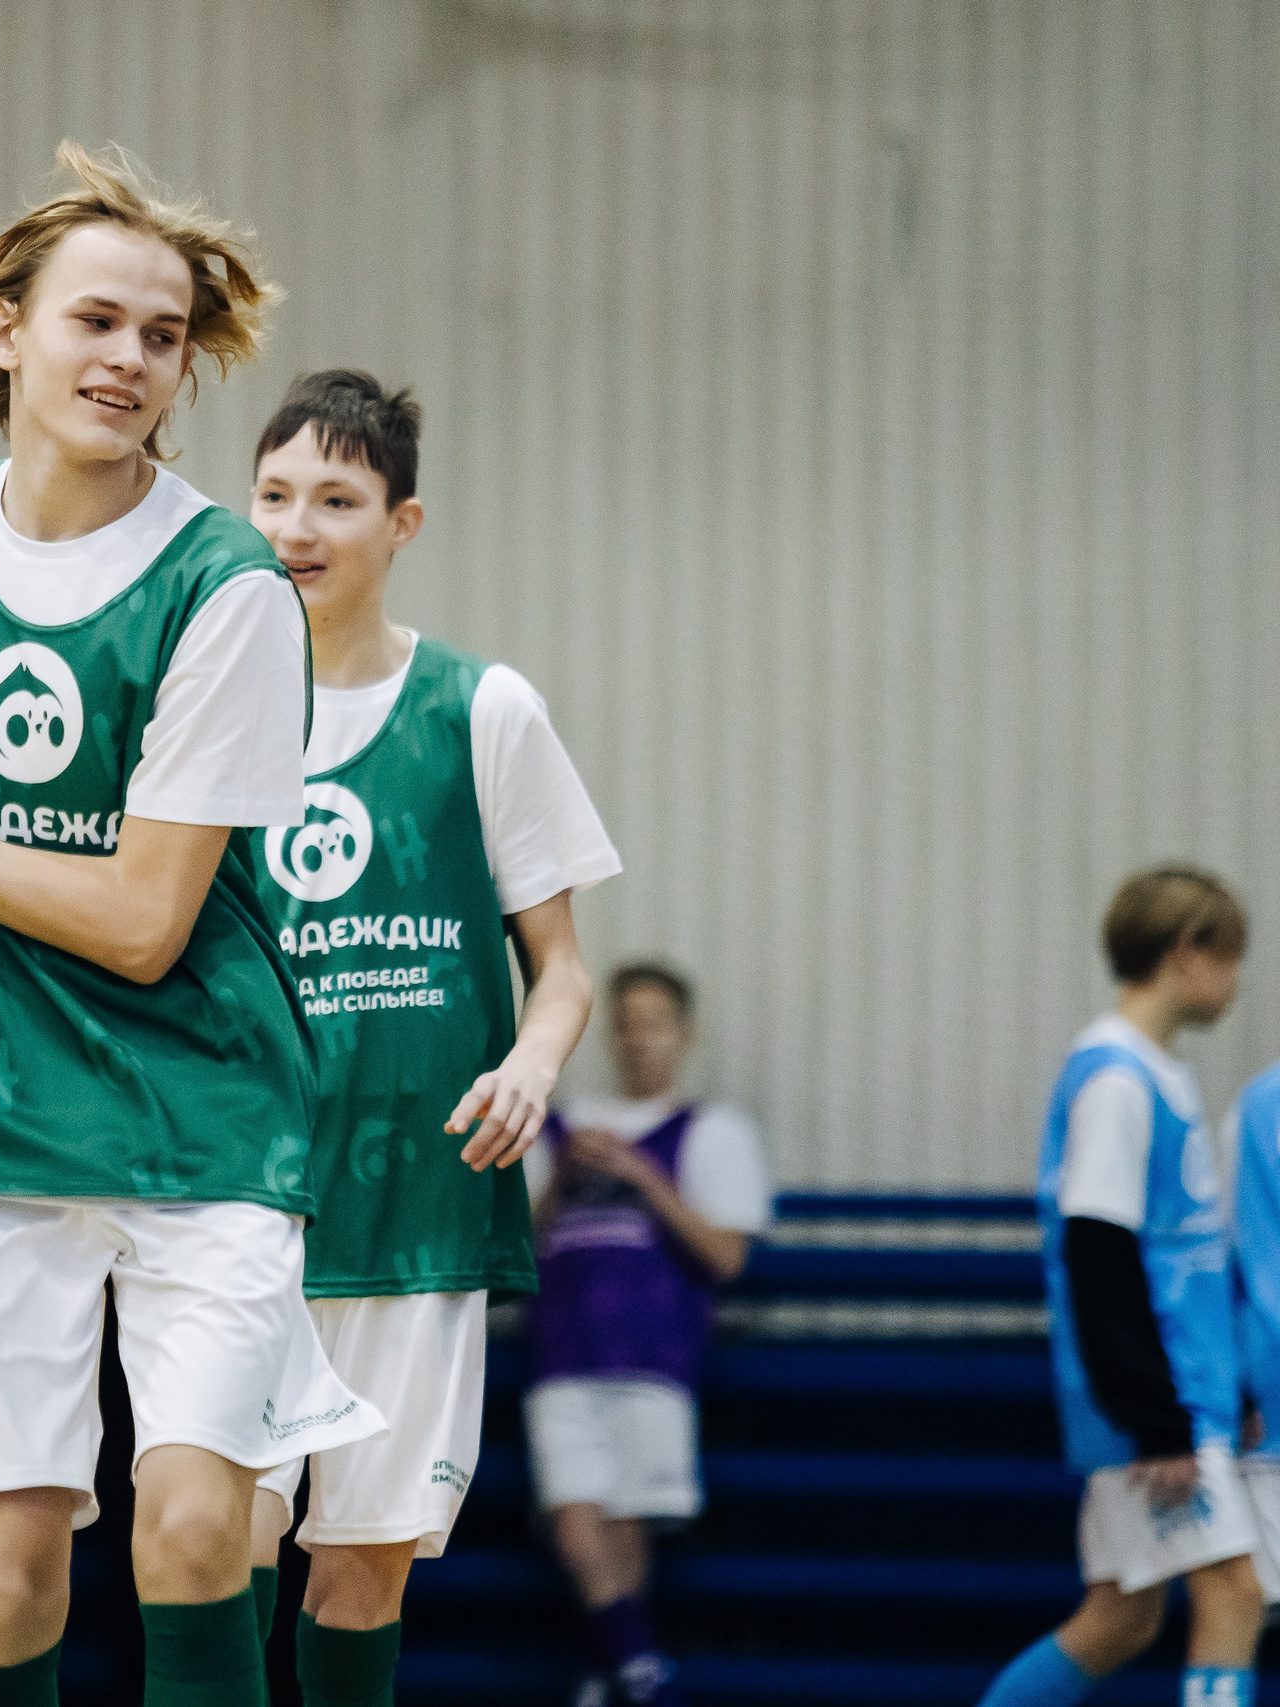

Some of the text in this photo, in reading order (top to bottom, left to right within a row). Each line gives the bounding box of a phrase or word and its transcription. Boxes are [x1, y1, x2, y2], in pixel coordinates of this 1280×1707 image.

[279, 914, 463, 958] АДЕЖДИК
[320, 974, 334, 993] К
[337, 966, 429, 990] ПОБЕДЕ!
[304, 988, 445, 1017] МЫ СИЛЬНЕЕ!
